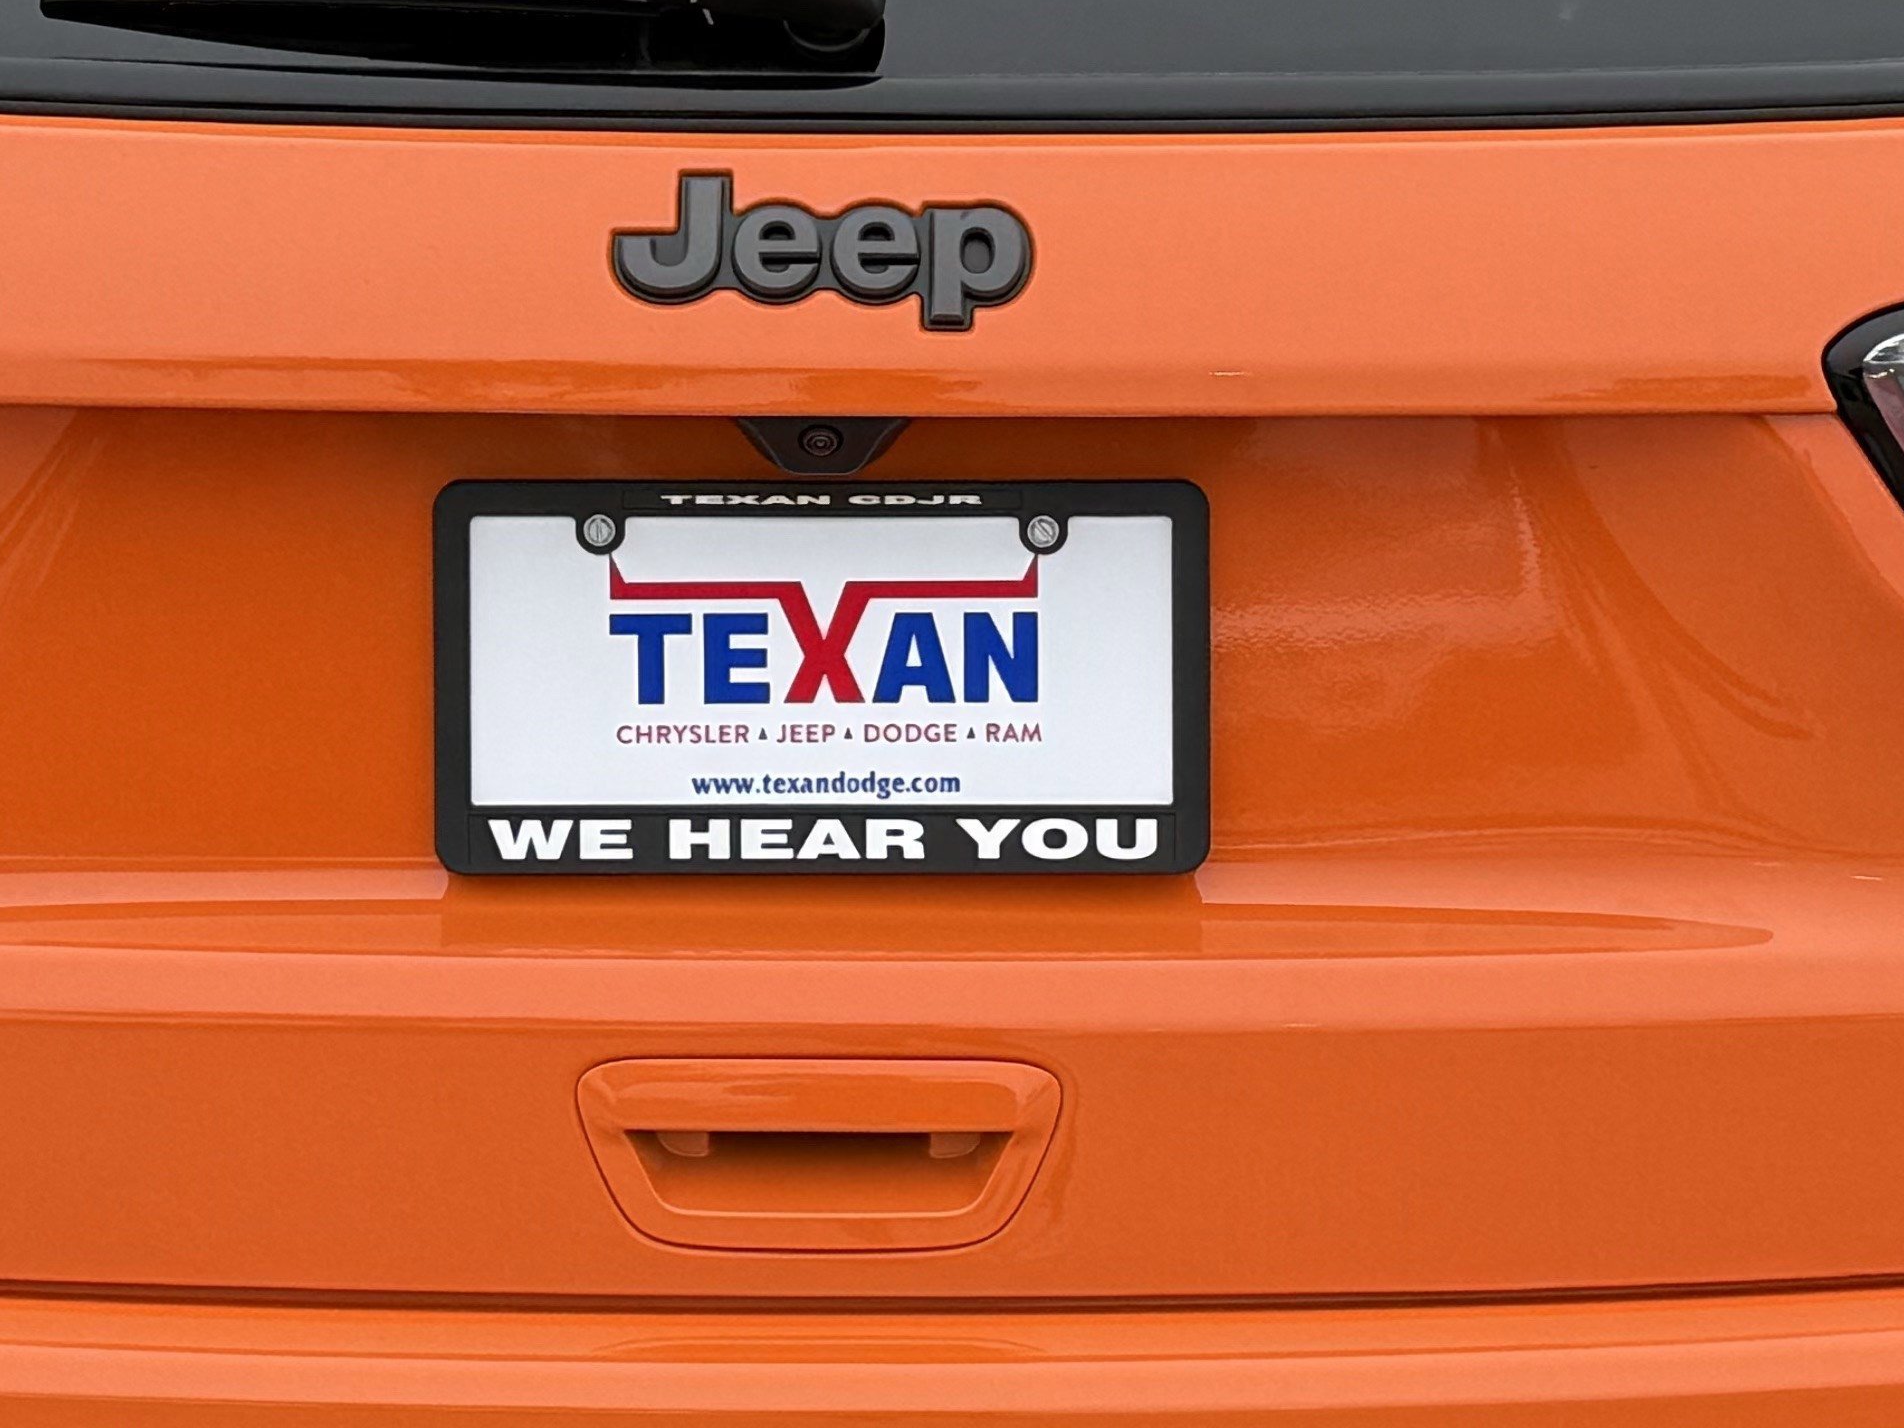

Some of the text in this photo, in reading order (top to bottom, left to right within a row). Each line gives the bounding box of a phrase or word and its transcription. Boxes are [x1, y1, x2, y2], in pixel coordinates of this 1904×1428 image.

[611, 170, 1033, 331] Jeep
[661, 495, 982, 505] TEXAN CDJR
[609, 582, 1039, 705] TEXAN
[616, 723, 1043, 745] CHRYSLER JEEP DODGE RAM
[691, 772, 961, 799] www.texandodge.com
[488, 817, 1158, 861] WE HEAR YOU
